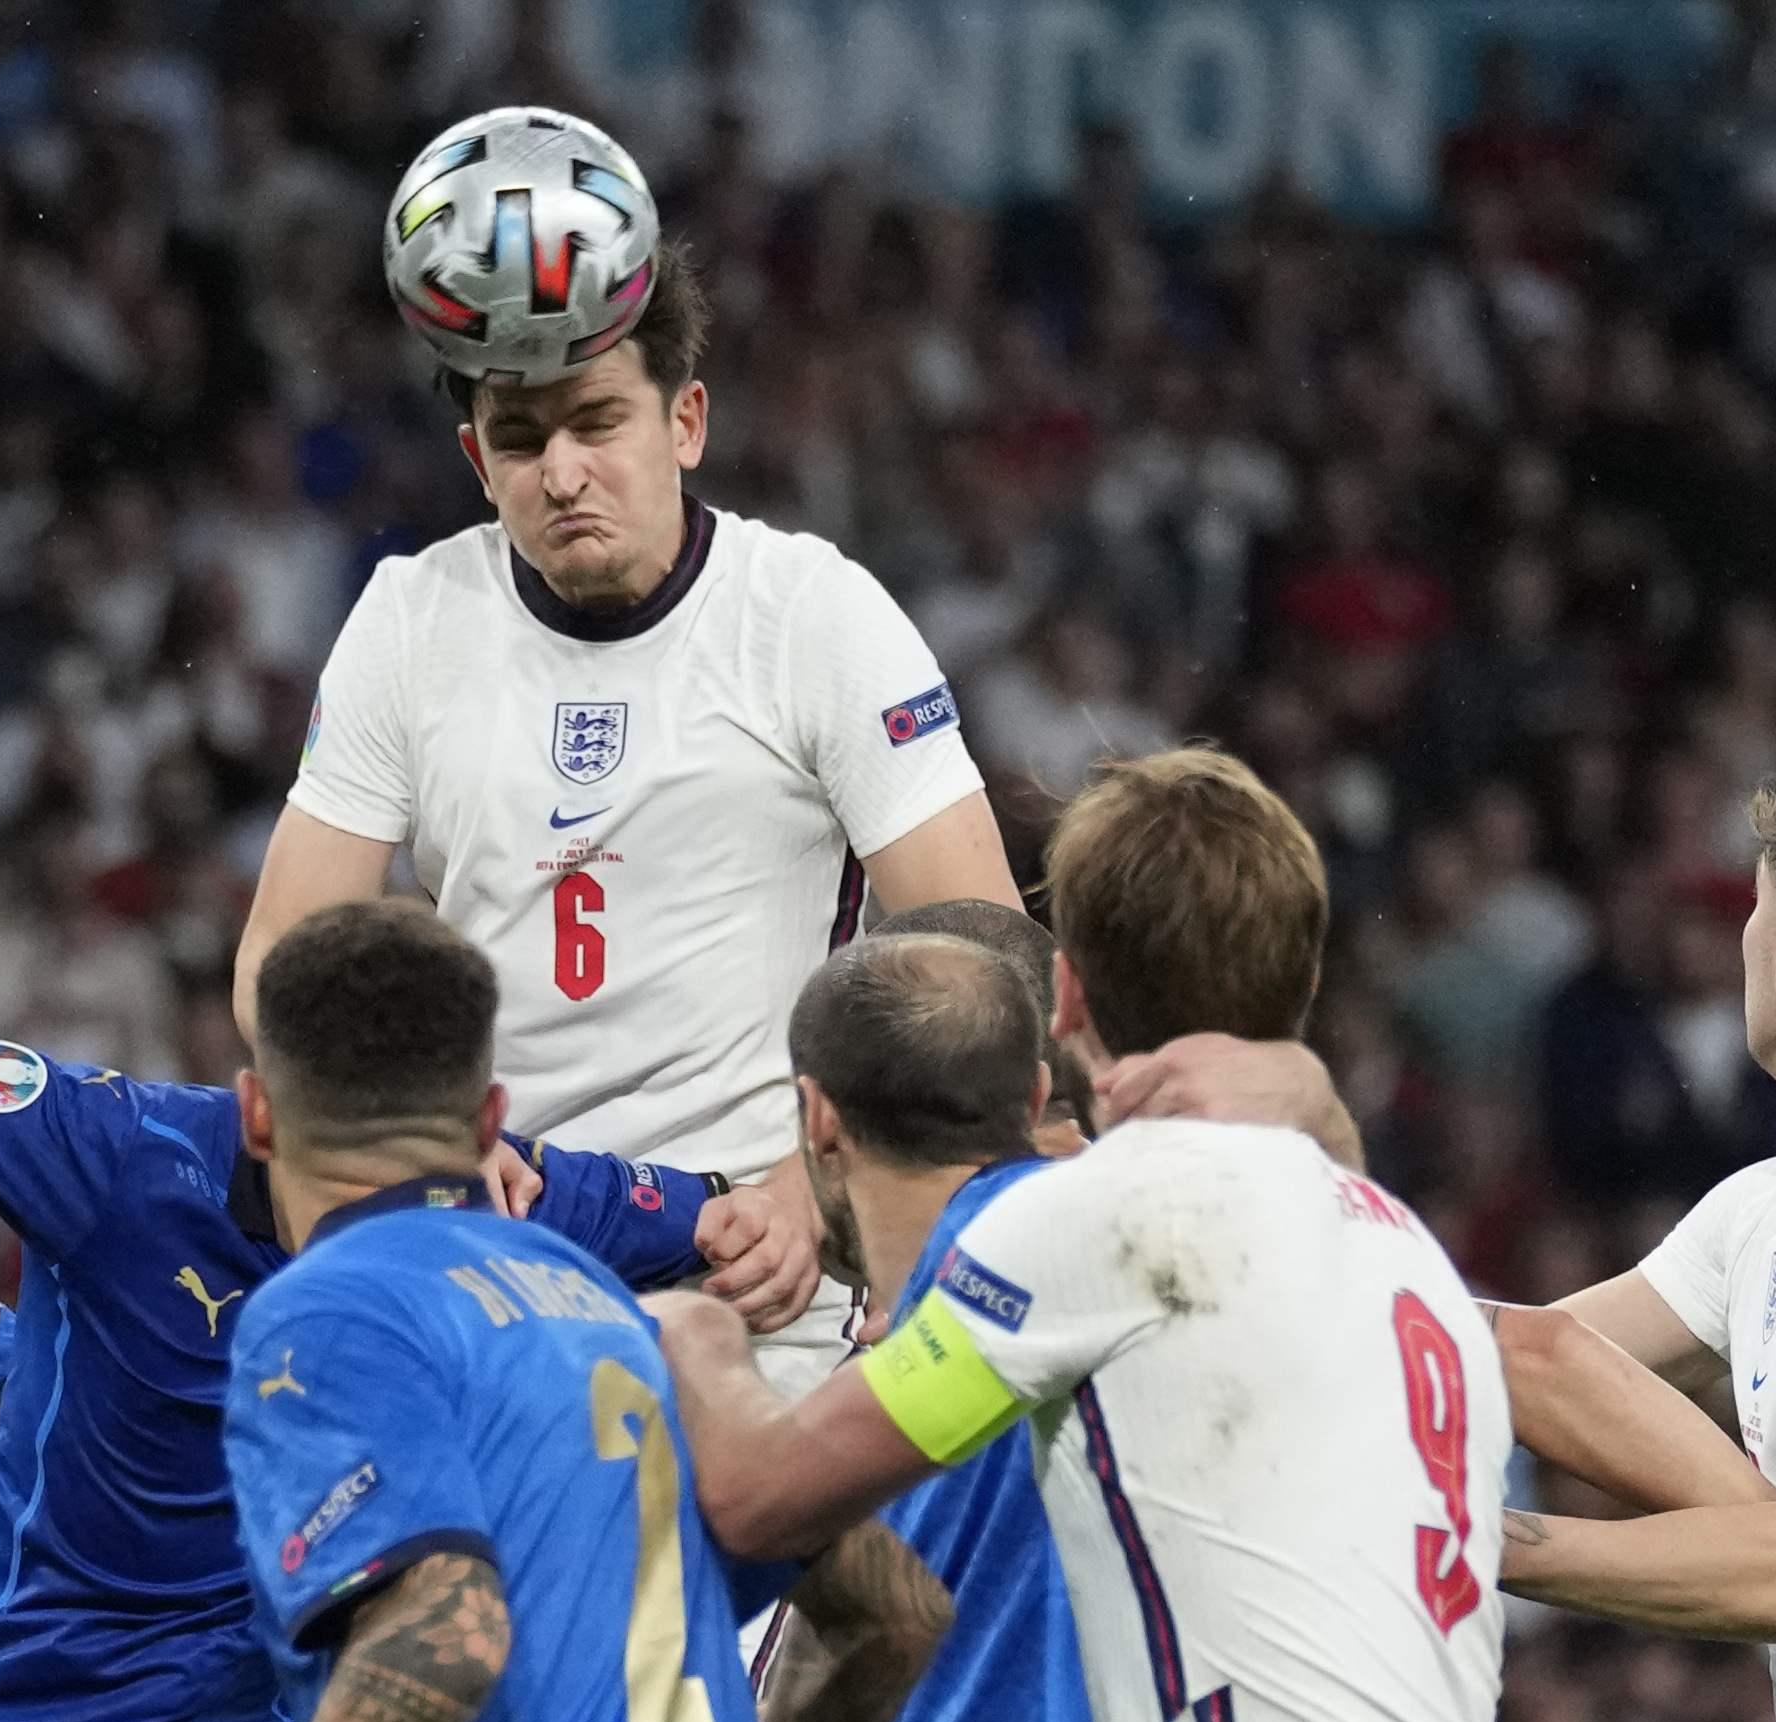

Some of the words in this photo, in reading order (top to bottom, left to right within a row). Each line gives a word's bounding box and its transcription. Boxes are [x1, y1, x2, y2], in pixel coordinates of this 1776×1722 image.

[554, 872, 605, 1002] 6
[946, 1264, 1025, 1323] RESPECT
[303, 1464, 376, 1542] RESPECT
[1392, 1288, 1479, 1640] 9
